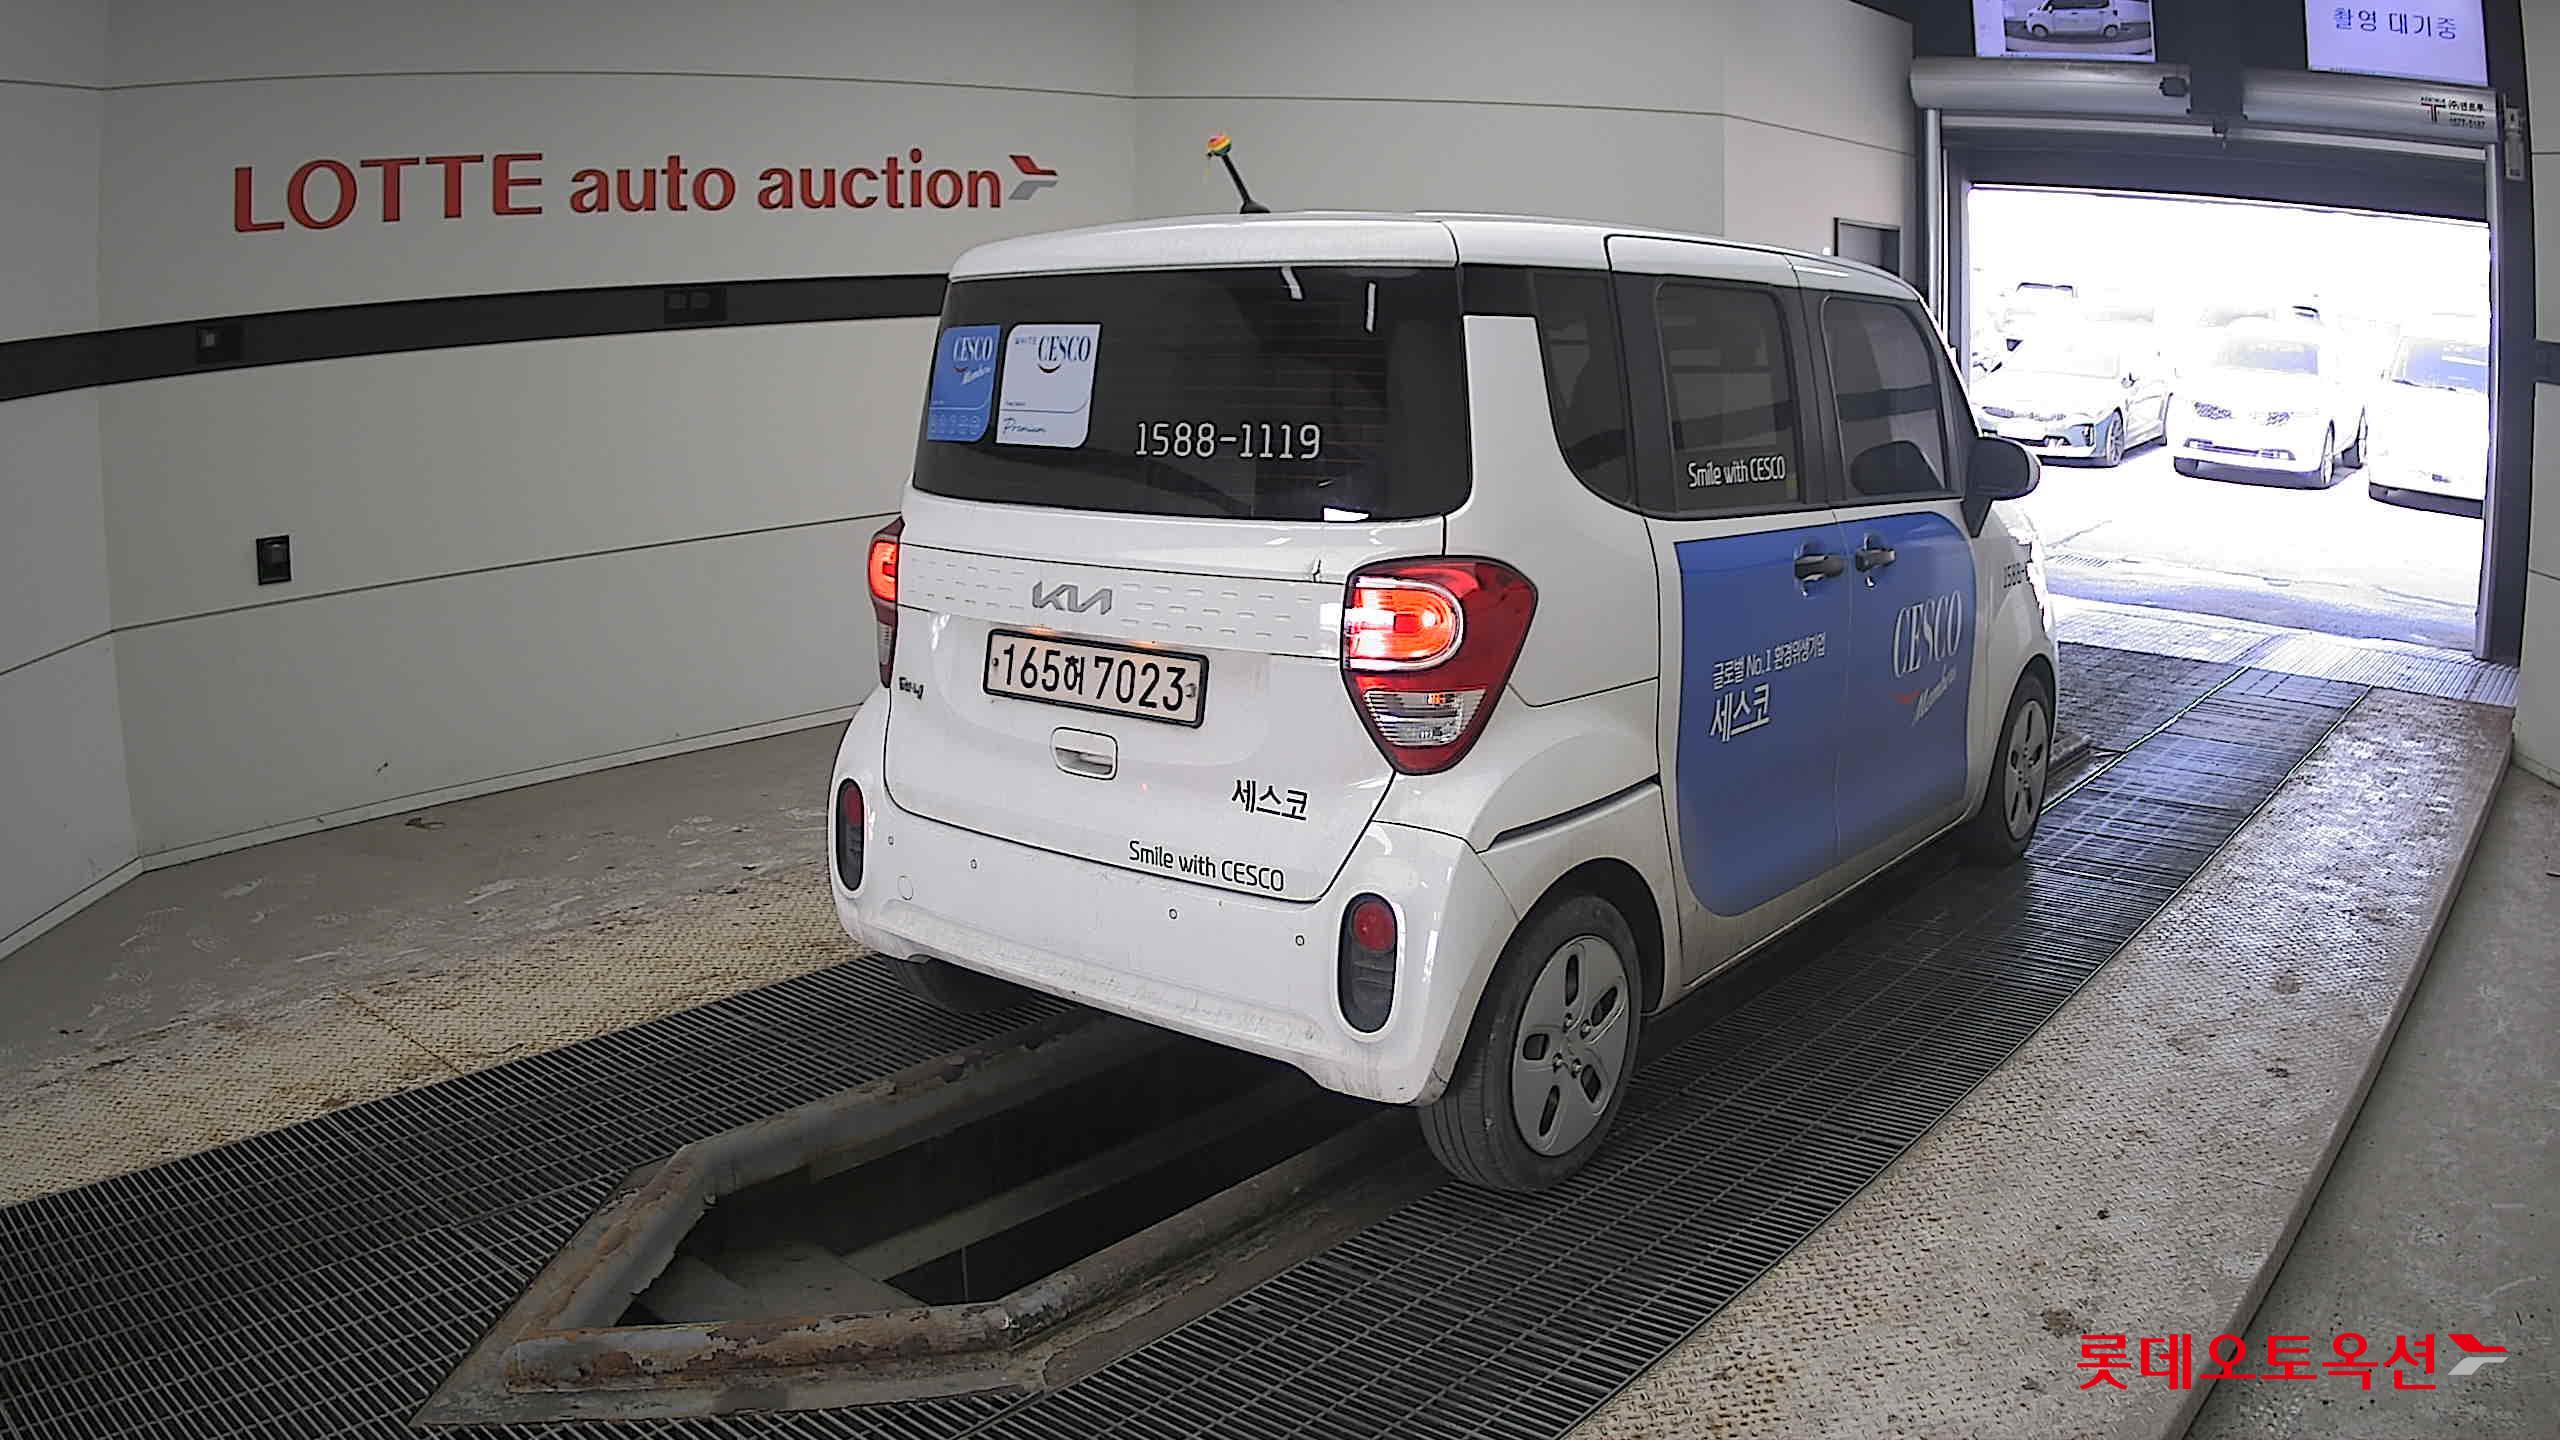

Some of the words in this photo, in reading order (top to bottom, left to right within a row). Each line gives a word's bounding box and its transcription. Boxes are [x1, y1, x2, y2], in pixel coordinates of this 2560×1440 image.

[2388, 12, 2457, 40] 대기중
[234, 152, 543, 233] LOTTE
[569, 154, 736, 214] auto
[757, 147, 1001, 211] auction
[952, 336, 994, 362] CESCO
[1038, 336, 1092, 363] CESCO
[1135, 421, 1322, 460] 1588-1119
[1687, 460, 1722, 488] Smile
[1723, 459, 1749, 484] with
[1749, 455, 1786, 482] CESCO
[1893, 589, 1962, 679] CESCO
[1712, 656, 1745, 691] 글로벌
[1710, 683, 1770, 742] 세스코
[1231, 779, 1307, 821] 세스코
[1128, 840, 1174, 869] Smile
[1178, 854, 1216, 879] with
[1220, 860, 1285, 892] CESCO
